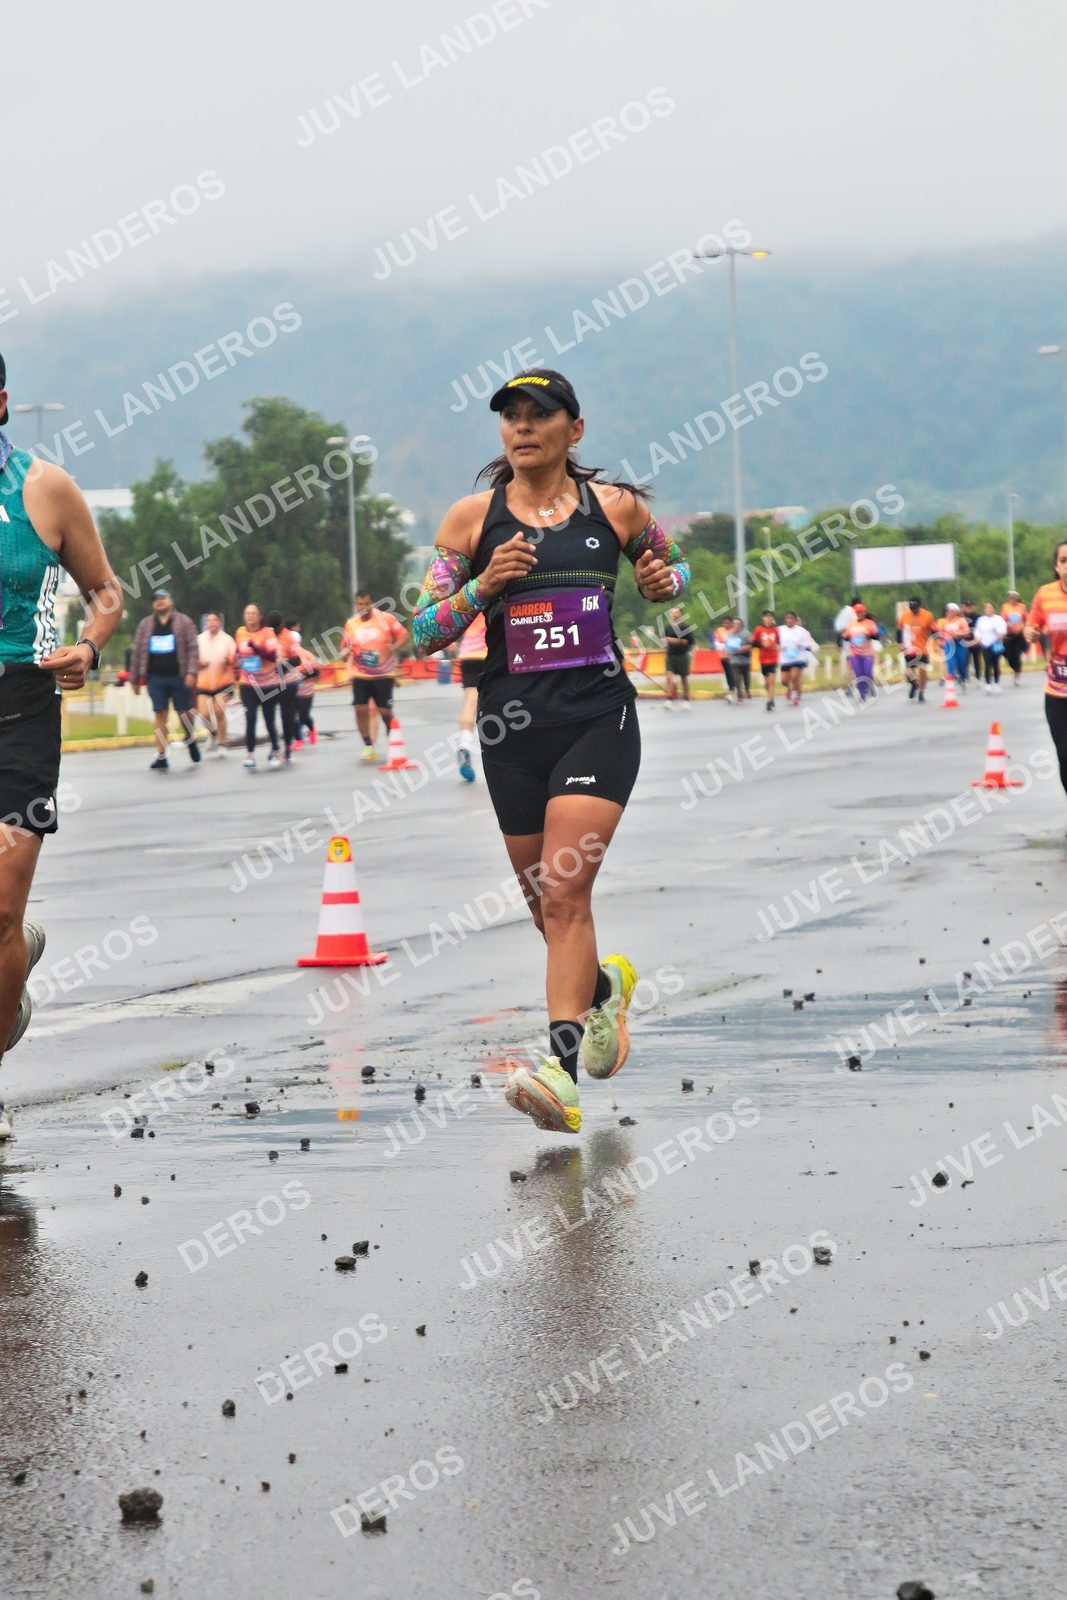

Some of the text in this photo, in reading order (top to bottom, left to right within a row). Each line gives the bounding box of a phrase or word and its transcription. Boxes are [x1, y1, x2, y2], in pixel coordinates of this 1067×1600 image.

[509, 602, 553, 617] CARRERA
[582, 595, 600, 612] 15K
[533, 624, 580, 650] 251
